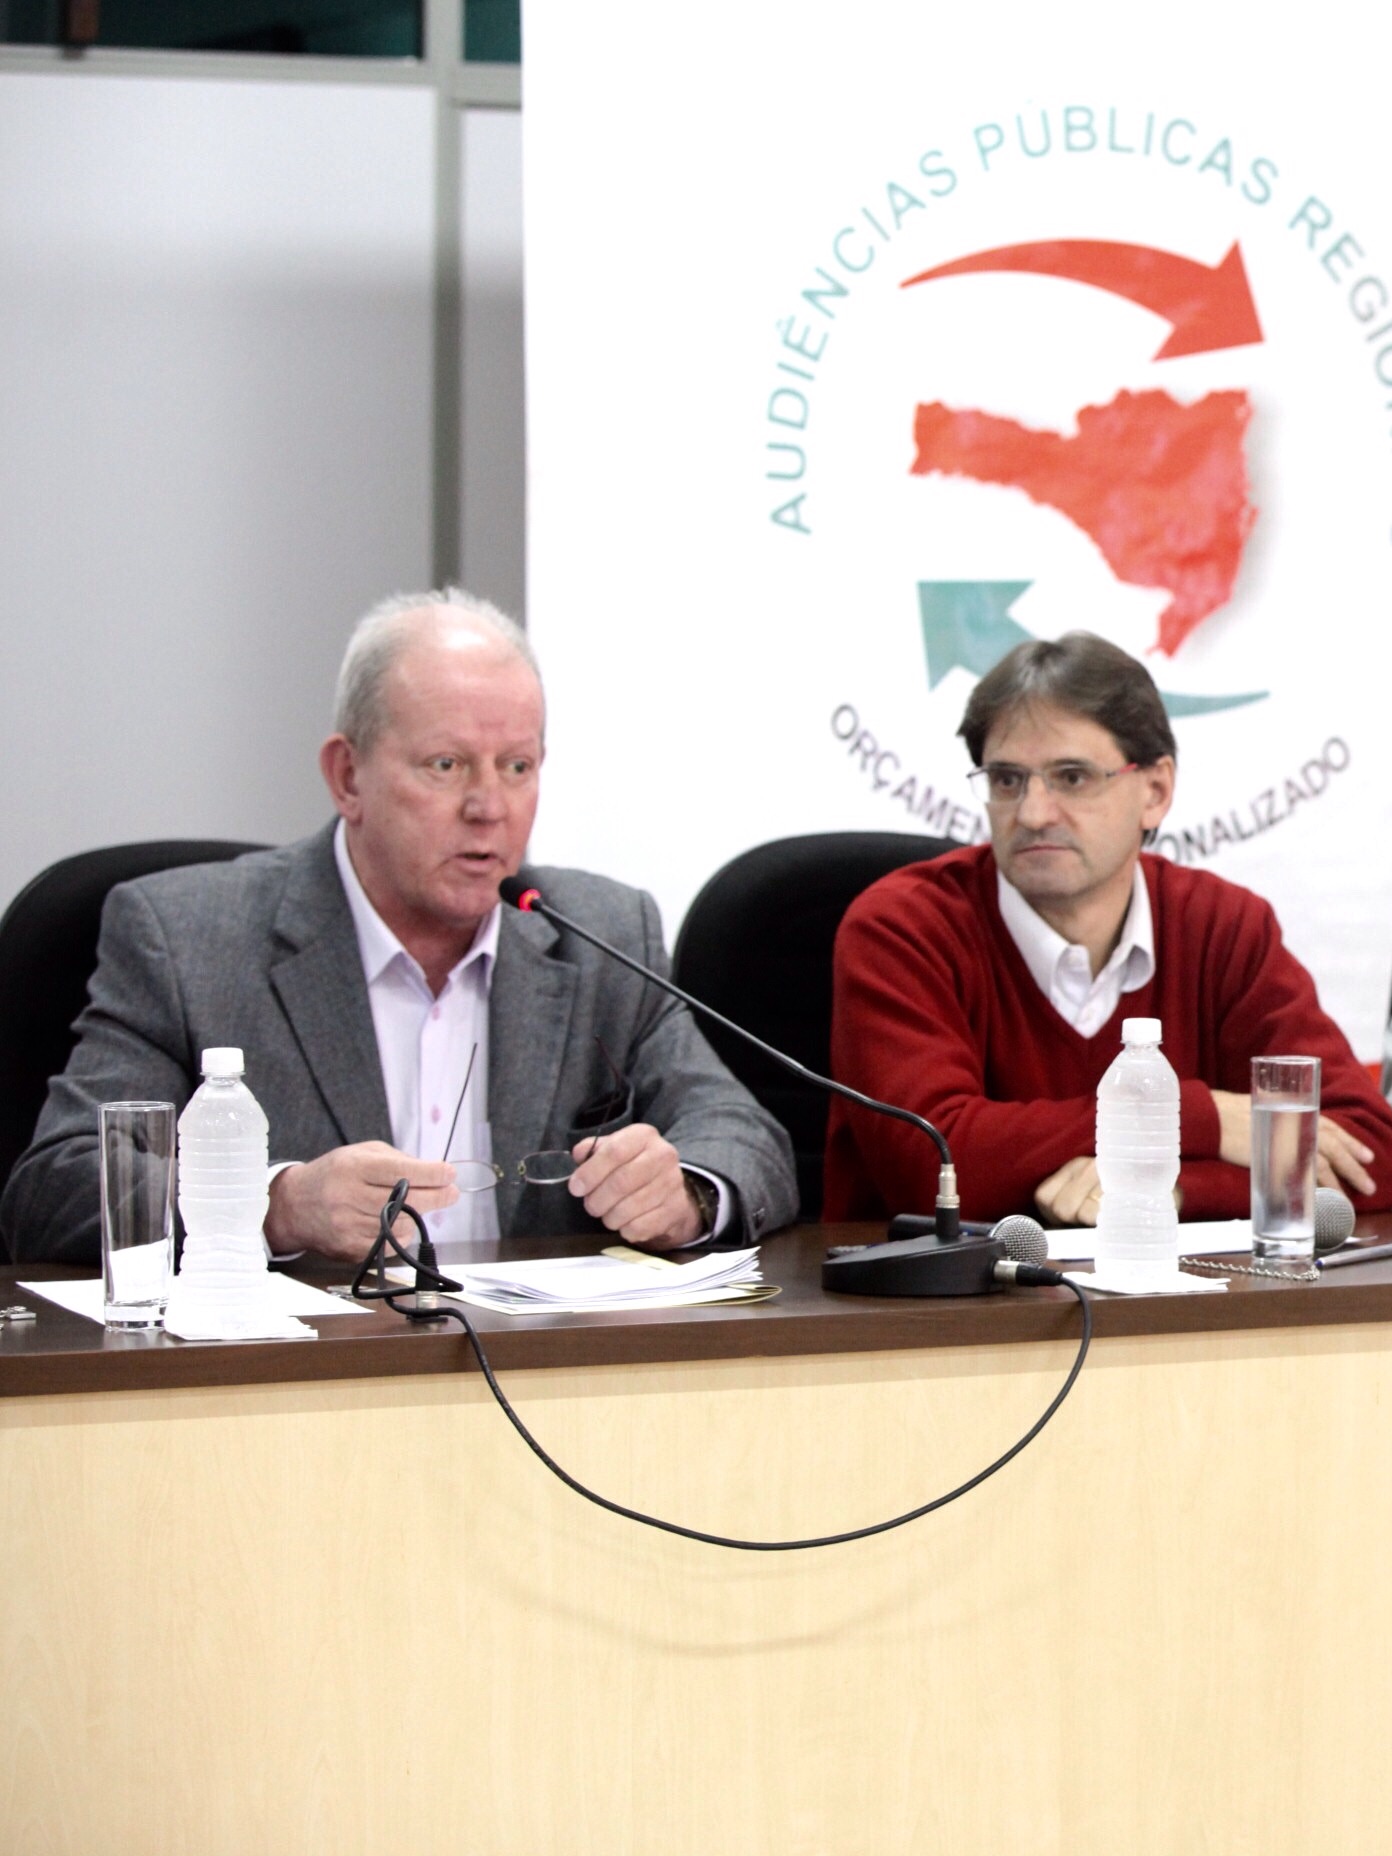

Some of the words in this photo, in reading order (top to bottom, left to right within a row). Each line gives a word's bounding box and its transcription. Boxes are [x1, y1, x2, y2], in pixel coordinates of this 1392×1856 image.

[766, 149, 958, 536] AUDIÊNCIAS
[973, 98, 1279, 206] PÚBLICAS
[830, 703, 991, 846] ORÇAMEN
[1154, 736, 1350, 865] ONALIZADO
